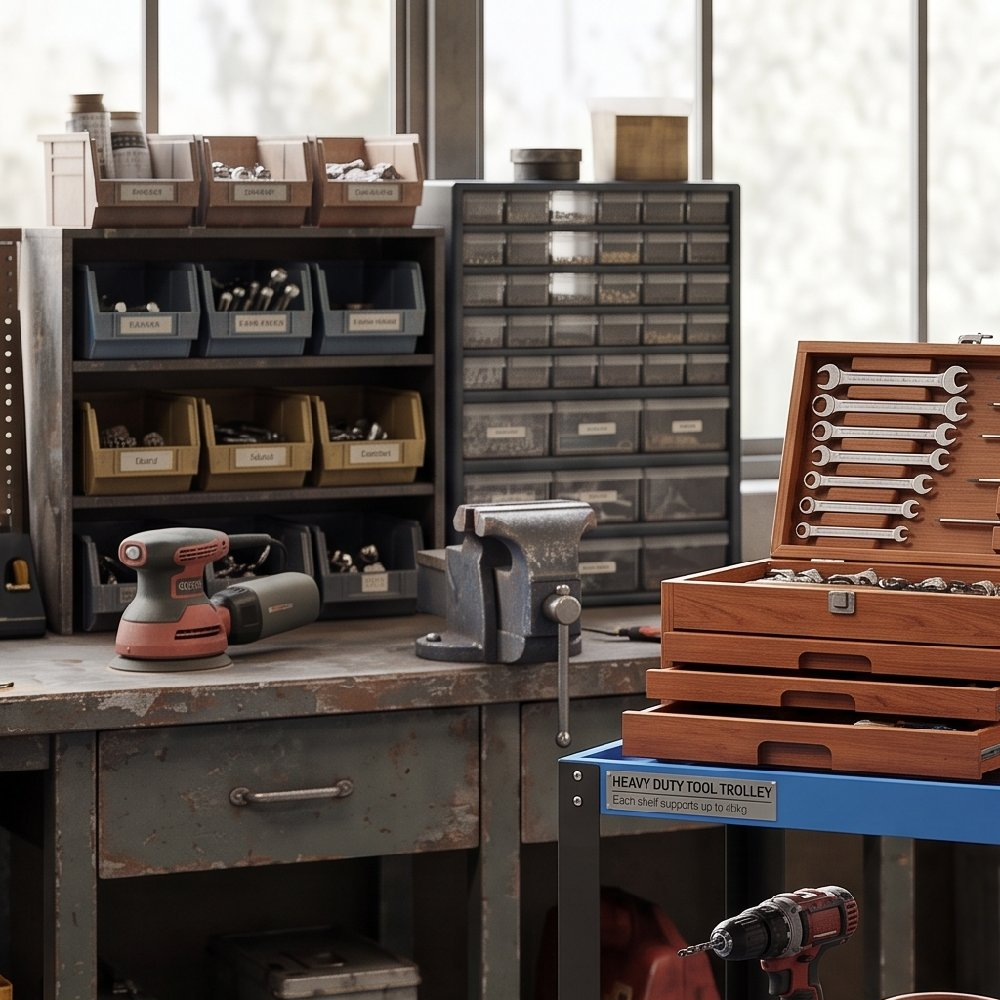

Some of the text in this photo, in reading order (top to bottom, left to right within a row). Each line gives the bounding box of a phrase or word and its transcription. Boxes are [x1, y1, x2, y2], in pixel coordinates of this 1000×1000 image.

[612, 776, 772, 799] HEAVY DUTY TOOL TROLLEY
[612, 795, 635, 806] Each
[637, 797, 659, 808] shelf
[701, 803, 712, 812] up
[715, 803, 723, 812] to
